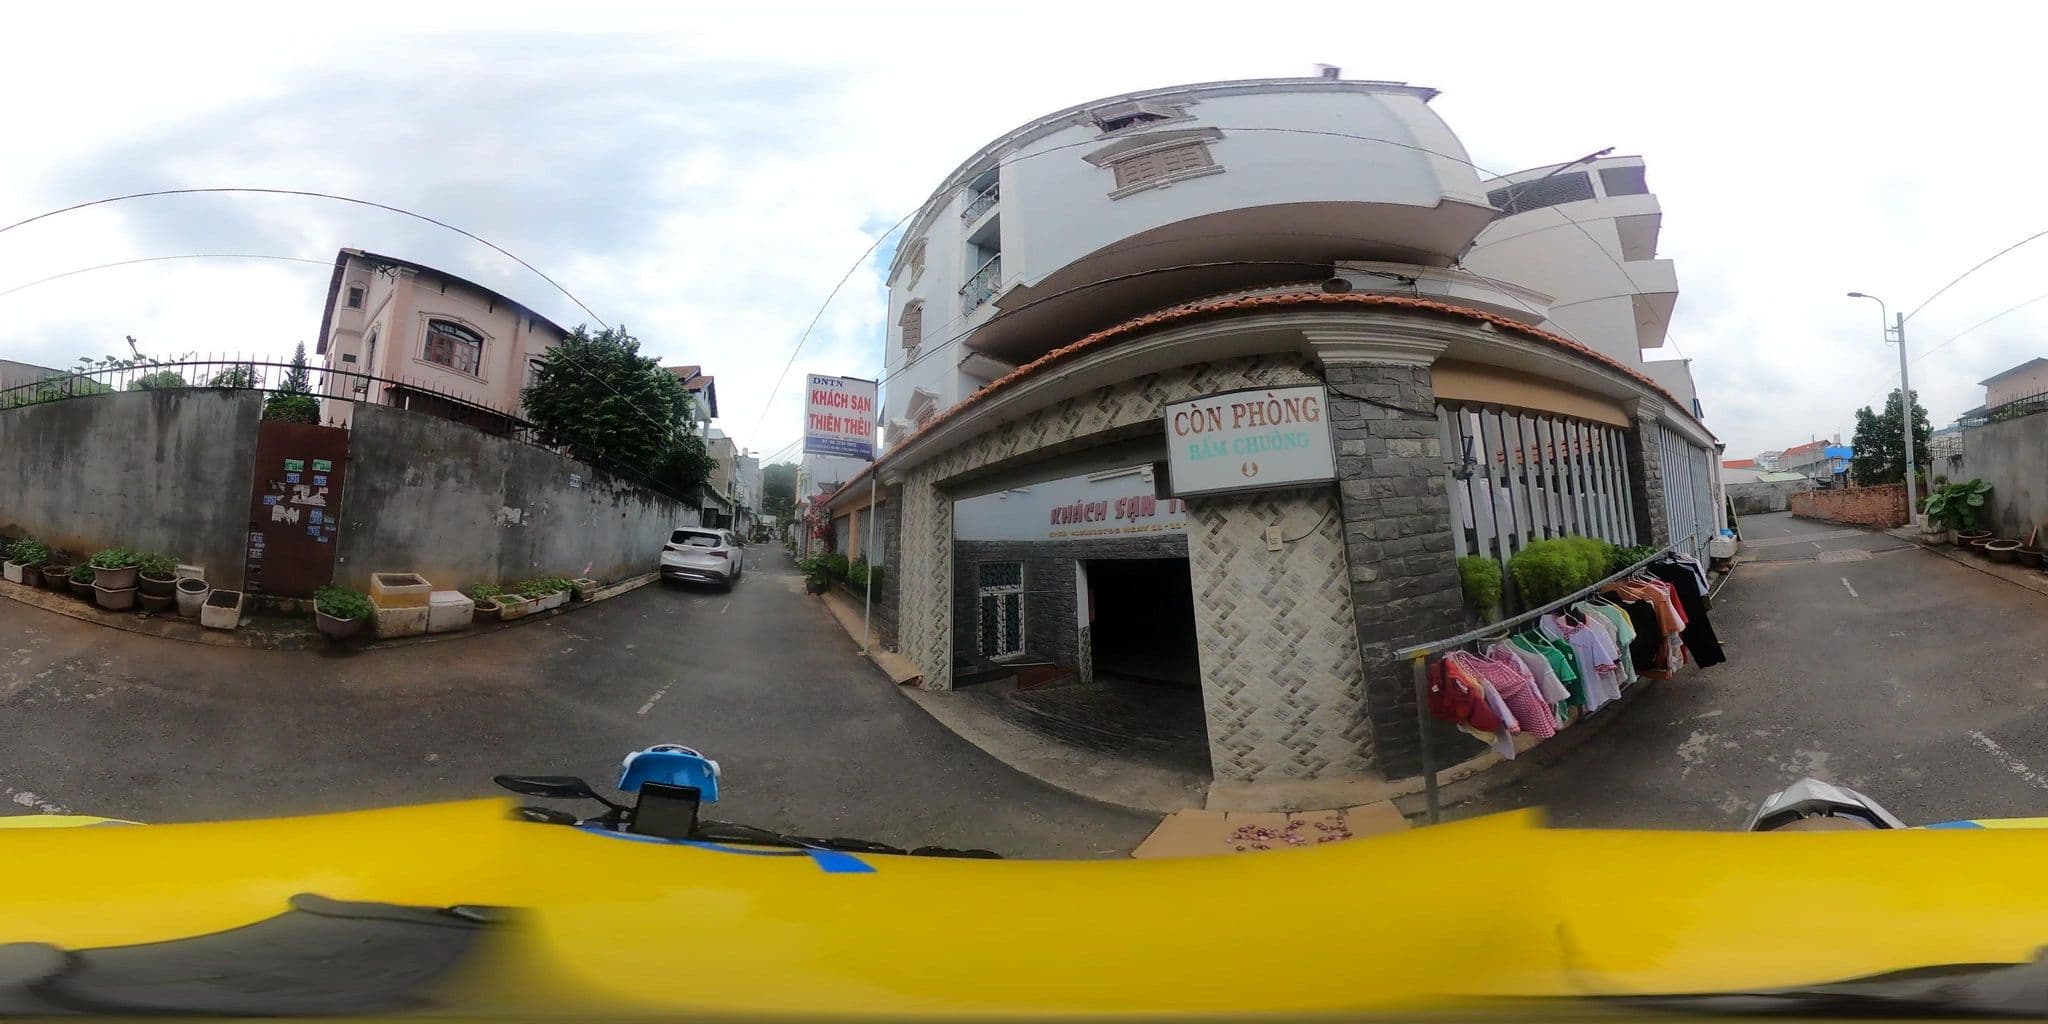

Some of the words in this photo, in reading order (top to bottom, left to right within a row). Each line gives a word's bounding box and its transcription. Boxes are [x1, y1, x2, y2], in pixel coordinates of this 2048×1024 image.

[813, 377, 843, 388] DNTN
[811, 389, 848, 409] KHÁCH
[851, 395, 871, 415] SẠN
[1174, 403, 1222, 437] CÒN
[1231, 392, 1320, 429] PHÒNG
[809, 412, 840, 433] THIÊN
[1233, 430, 1310, 455] CHUÔNG
[1051, 500, 1107, 525] KHÁCH
[1114, 494, 1156, 523] SẠN
